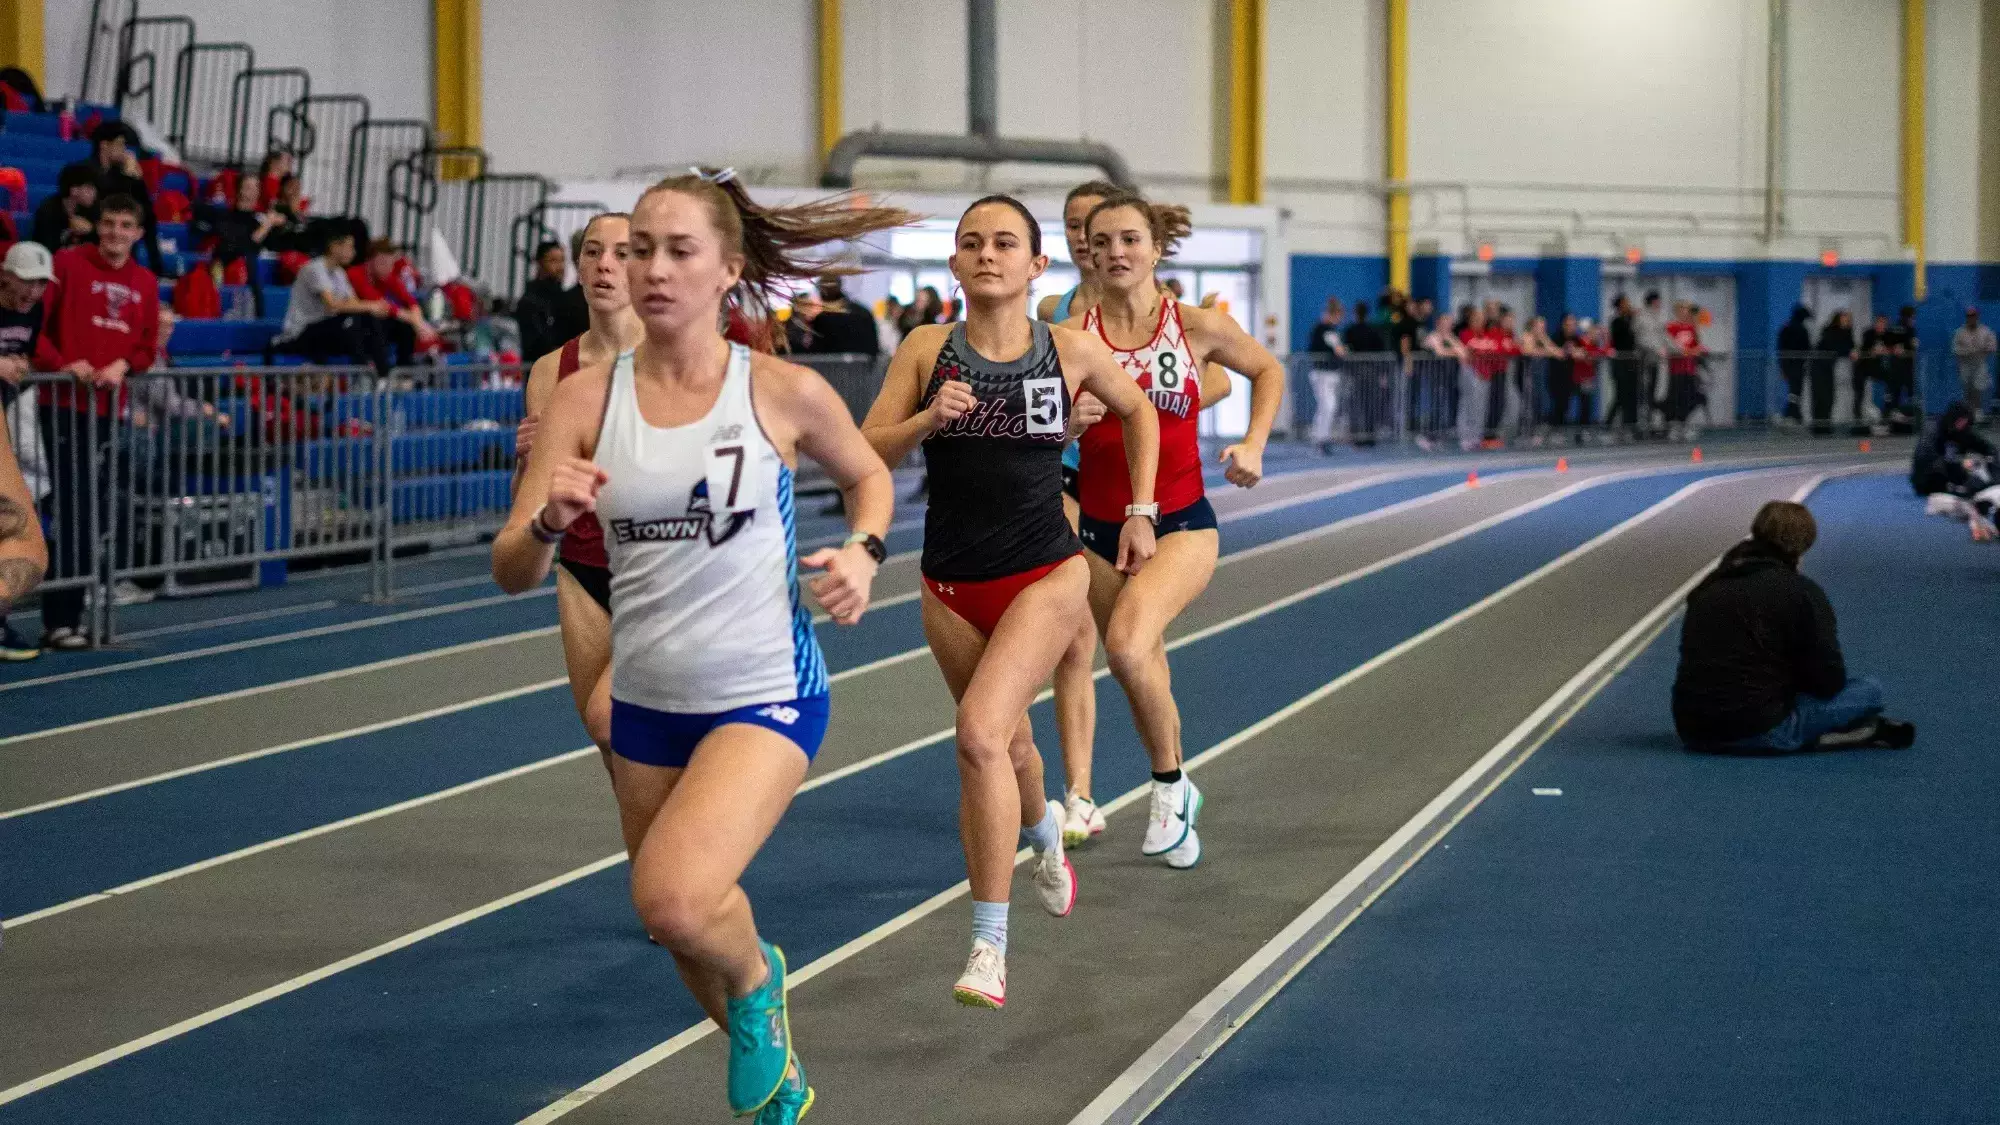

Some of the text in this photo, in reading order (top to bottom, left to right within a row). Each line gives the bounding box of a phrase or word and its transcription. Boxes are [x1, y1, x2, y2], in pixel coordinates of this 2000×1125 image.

[1158, 352, 1178, 388] 8
[1030, 386, 1058, 426] 5
[714, 446, 744, 508] 7
